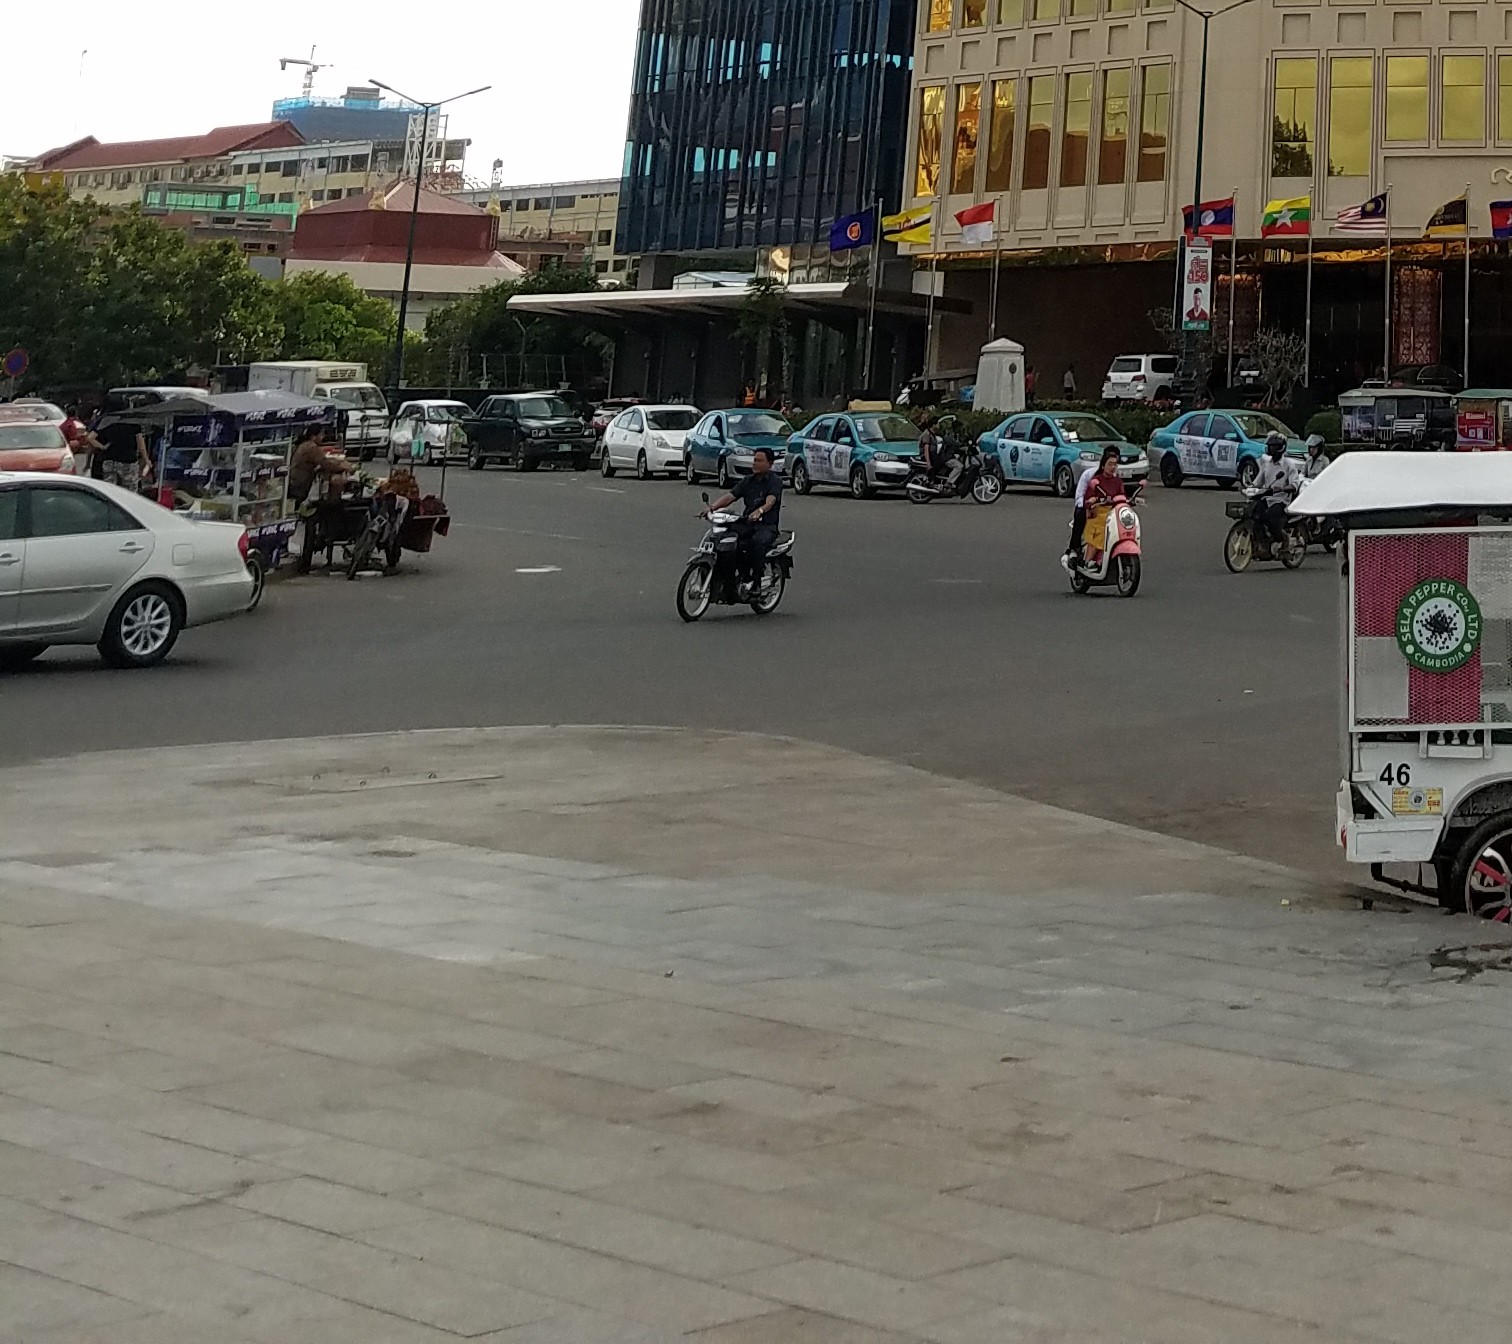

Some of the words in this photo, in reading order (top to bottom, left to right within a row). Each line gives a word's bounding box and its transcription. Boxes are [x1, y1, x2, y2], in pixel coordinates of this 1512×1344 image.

[1400, 607, 1413, 642] SELA
[1409, 582, 1456, 606] PEPPER
[1467, 613, 1479, 640] LTD
[1414, 651, 1465, 667] CAMBODIA
[1379, 762, 1411, 786] 46
